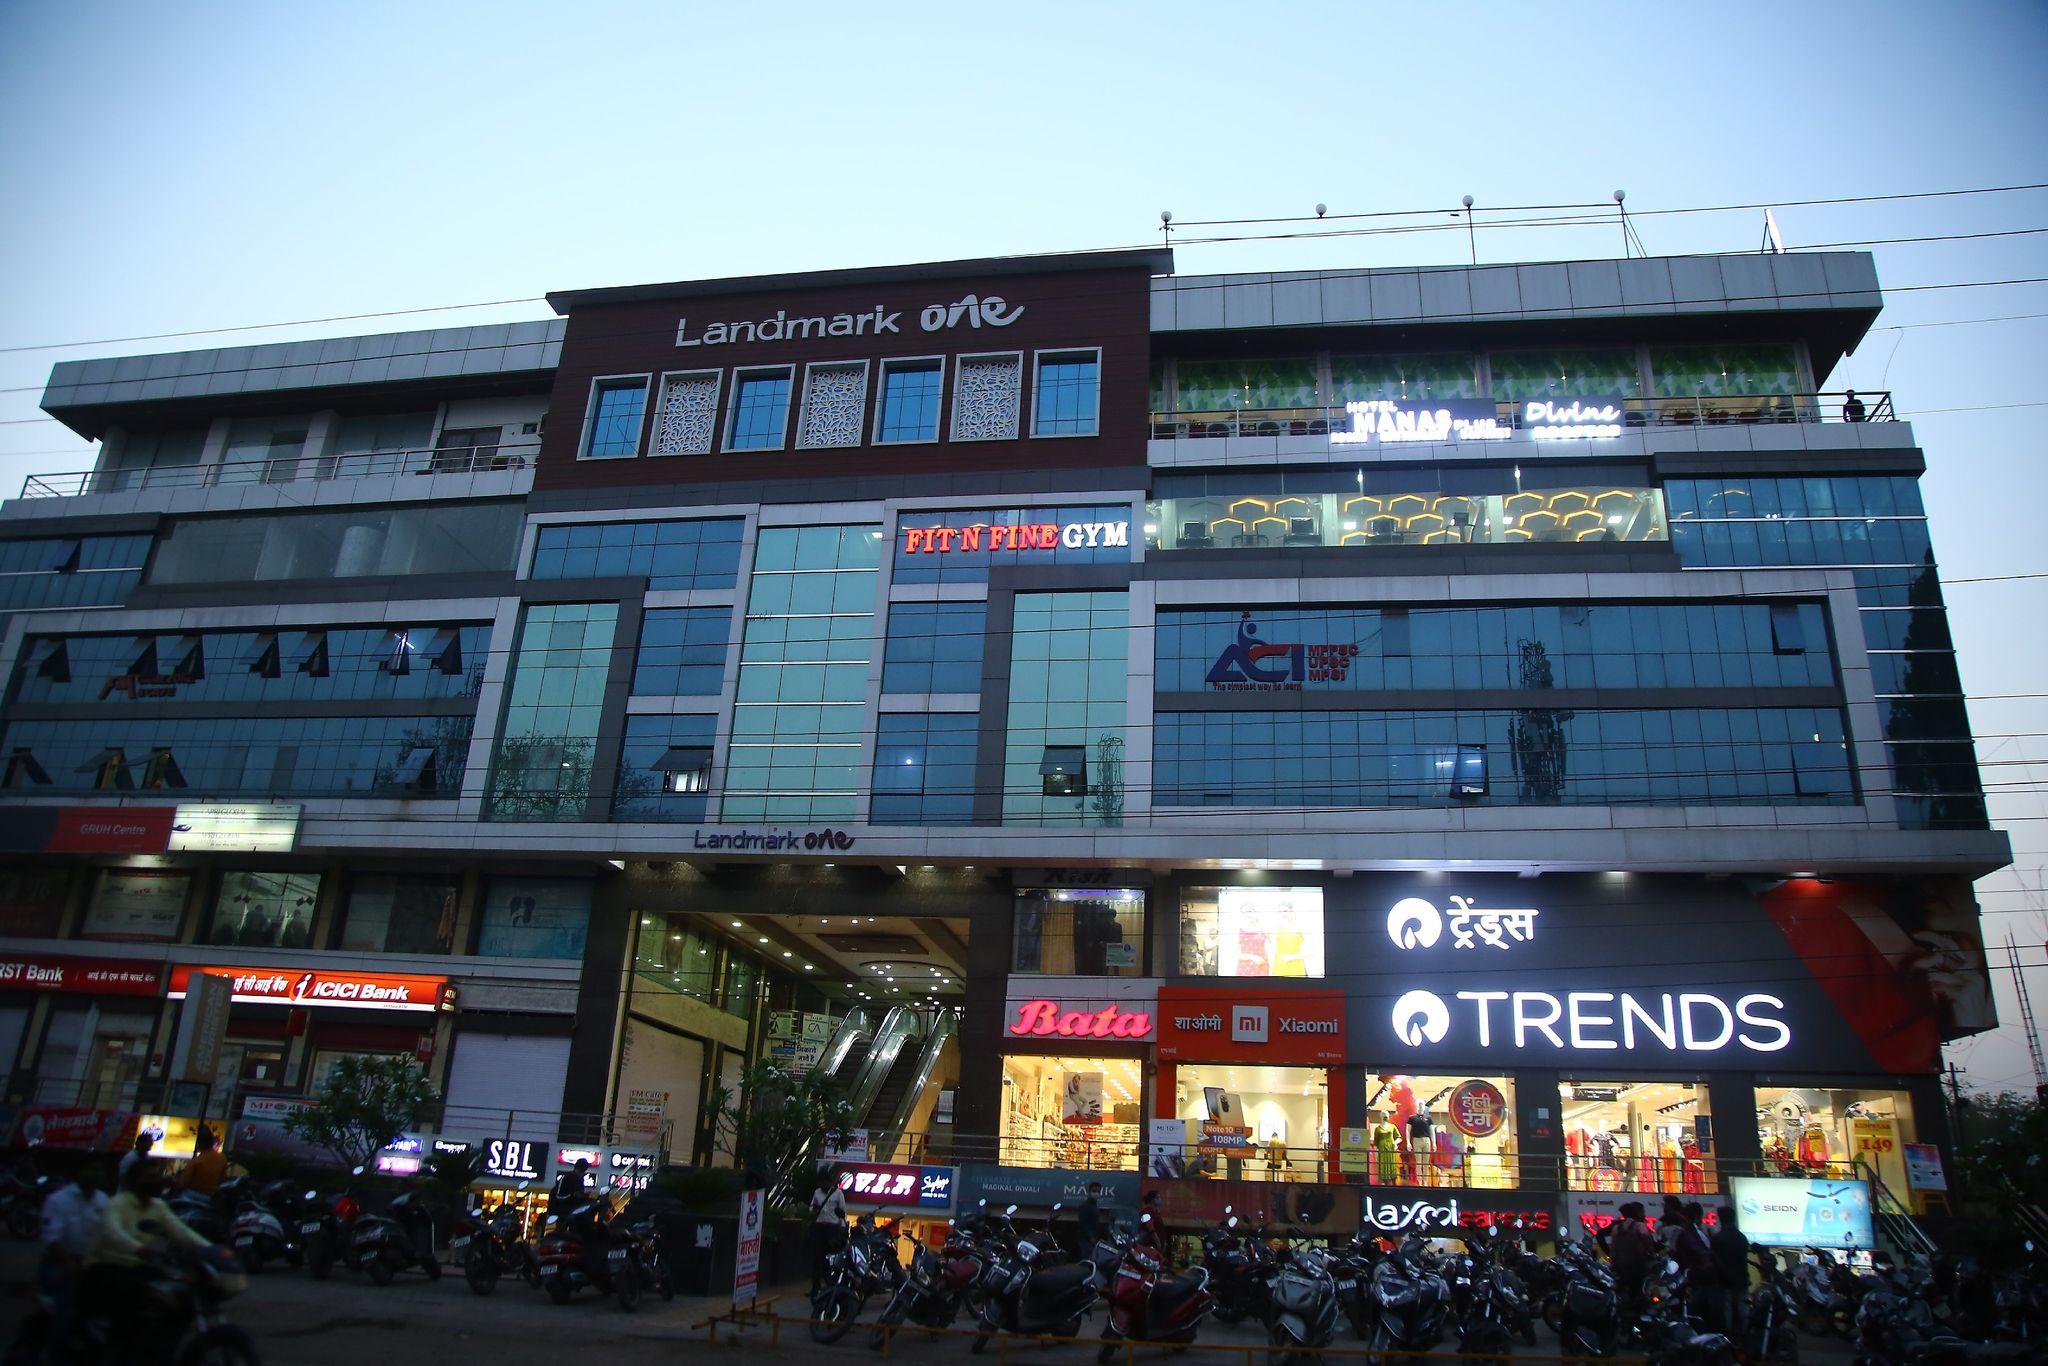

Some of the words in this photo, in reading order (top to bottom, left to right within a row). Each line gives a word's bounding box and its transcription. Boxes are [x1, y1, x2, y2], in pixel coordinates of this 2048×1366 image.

[675, 305, 903, 346] Landmark
[920, 294, 1025, 331] one
[1347, 401, 1397, 412] HOTEL
[1527, 401, 1620, 421] Divine
[1354, 410, 1452, 433] MANAS
[1454, 419, 1496, 431] PLUS
[905, 528, 955, 552] FIT
[961, 527, 981, 551] N
[989, 524, 1059, 551] FINE
[1062, 521, 1129, 549] GYM
[1308, 645, 1359, 656] MPPSC
[1308, 657, 1350, 669] UPSC
[80, 823, 110, 835] GRUH
[113, 824, 146, 836] Centre
[694, 830, 799, 850] Landmark
[804, 828, 855, 850] one
[26, 964, 64, 982] Bank
[312, 981, 360, 998] ICICI
[360, 984, 410, 1000] Bank
[1009, 999, 1153, 1039] Bata
[1280, 1017, 1339, 1033] Xiaomi
[1456, 991, 1791, 1052] TRENDS
[1206, 1125, 1224, 1133] Note
[1213, 1136, 1243, 1145] 108MP
[1861, 1139, 1892, 1152] 149
[488, 1140, 532, 1171] SBL
[1015, 1185, 1040, 1193] DIWALI
[1063, 1184, 1116, 1197] MAIK
[1366, 1196, 1458, 1231] laxmi
